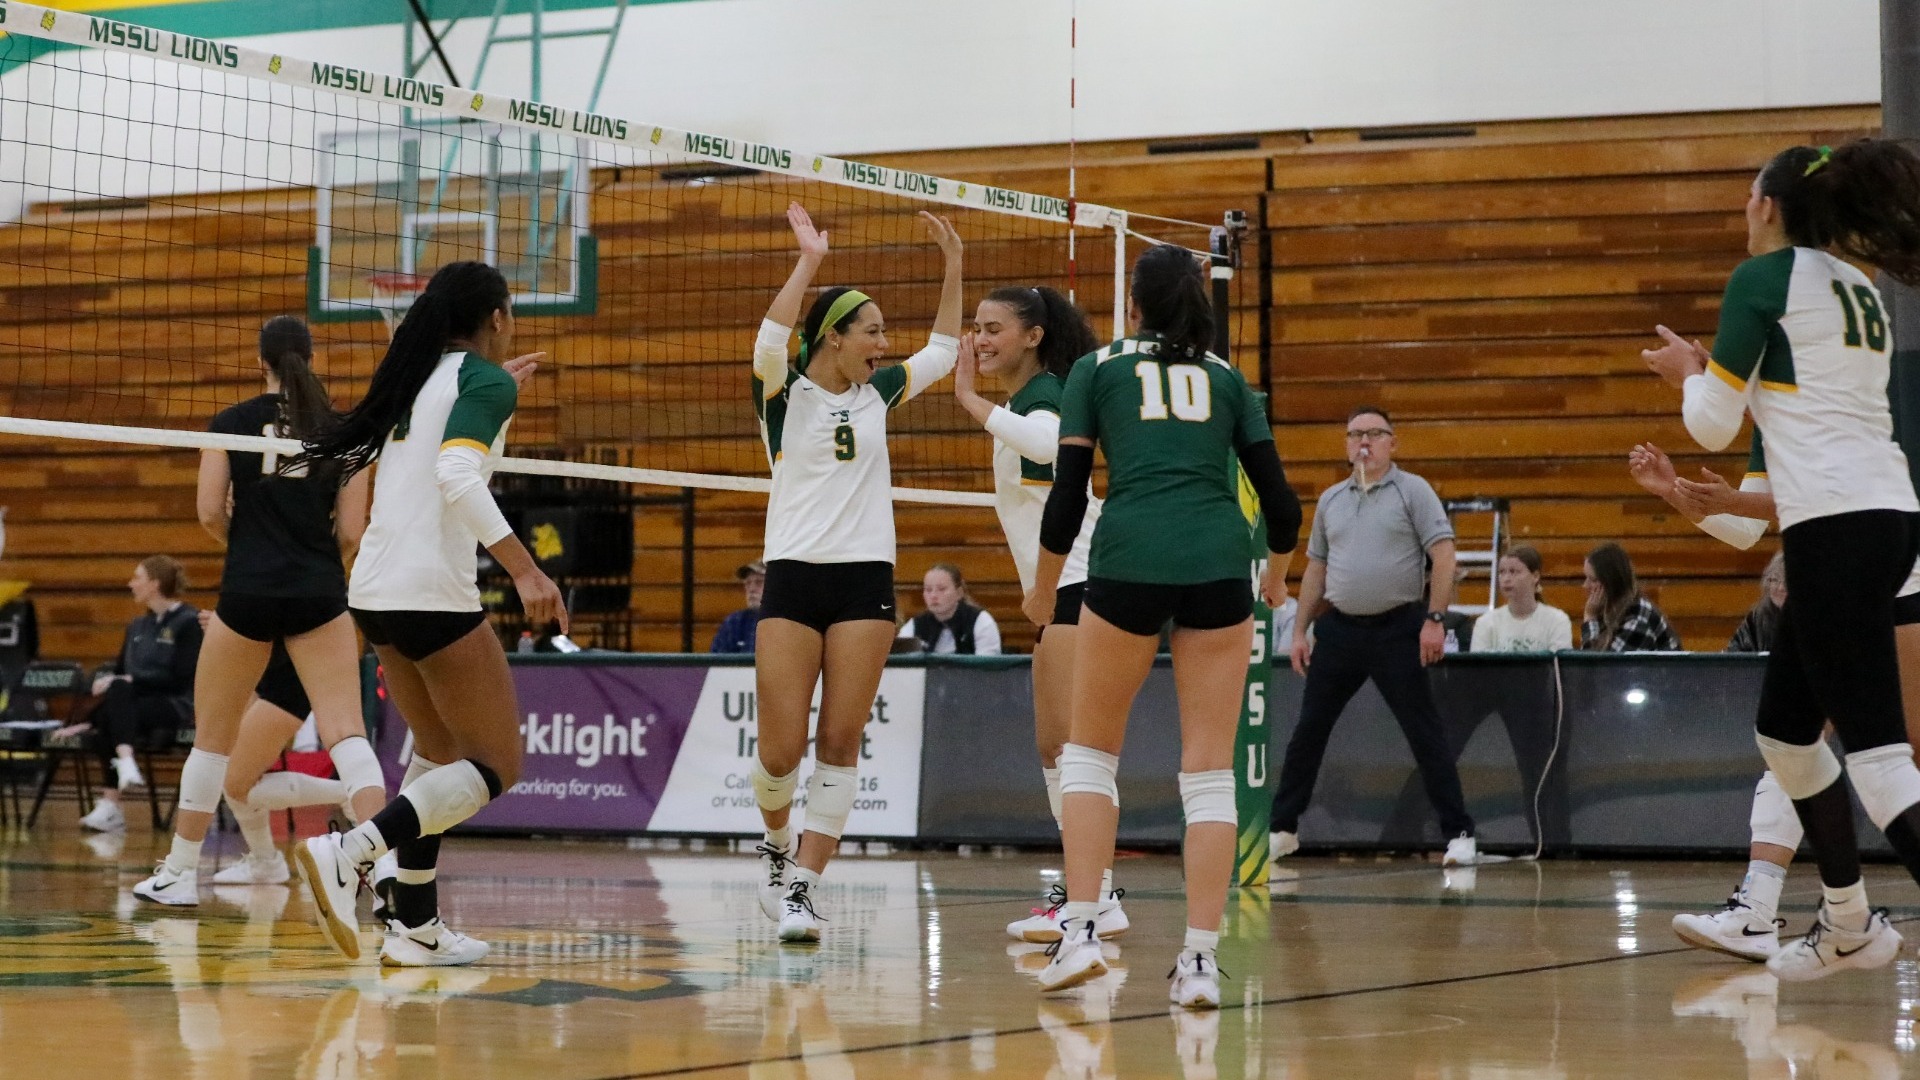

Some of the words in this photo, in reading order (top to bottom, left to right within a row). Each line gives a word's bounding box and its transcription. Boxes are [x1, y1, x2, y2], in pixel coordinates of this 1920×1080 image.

[89, 17, 158, 52] MSSU
[171, 33, 238, 68] LIONS
[311, 62, 374, 93] MSSU
[384, 75, 444, 106] LIONS
[508, 99, 565, 128] MSSU
[573, 111, 627, 139] LIONS
[684, 132, 735, 159] MSSU
[743, 143, 791, 169] LIONS
[842, 161, 887, 186] MSSU
[894, 170, 938, 195] LIONS
[984, 187, 1025, 210] MSSU
[1031, 196, 1069, 218] LIONS
[1831, 279, 1885, 351] 18
[1135, 360, 1211, 422] 10
[834, 425, 855, 461] 9
[519, 713, 649, 767] klight
[569, 778, 591, 796] for
[592, 783, 627, 800] you.
[731, 793, 757, 808] visi
